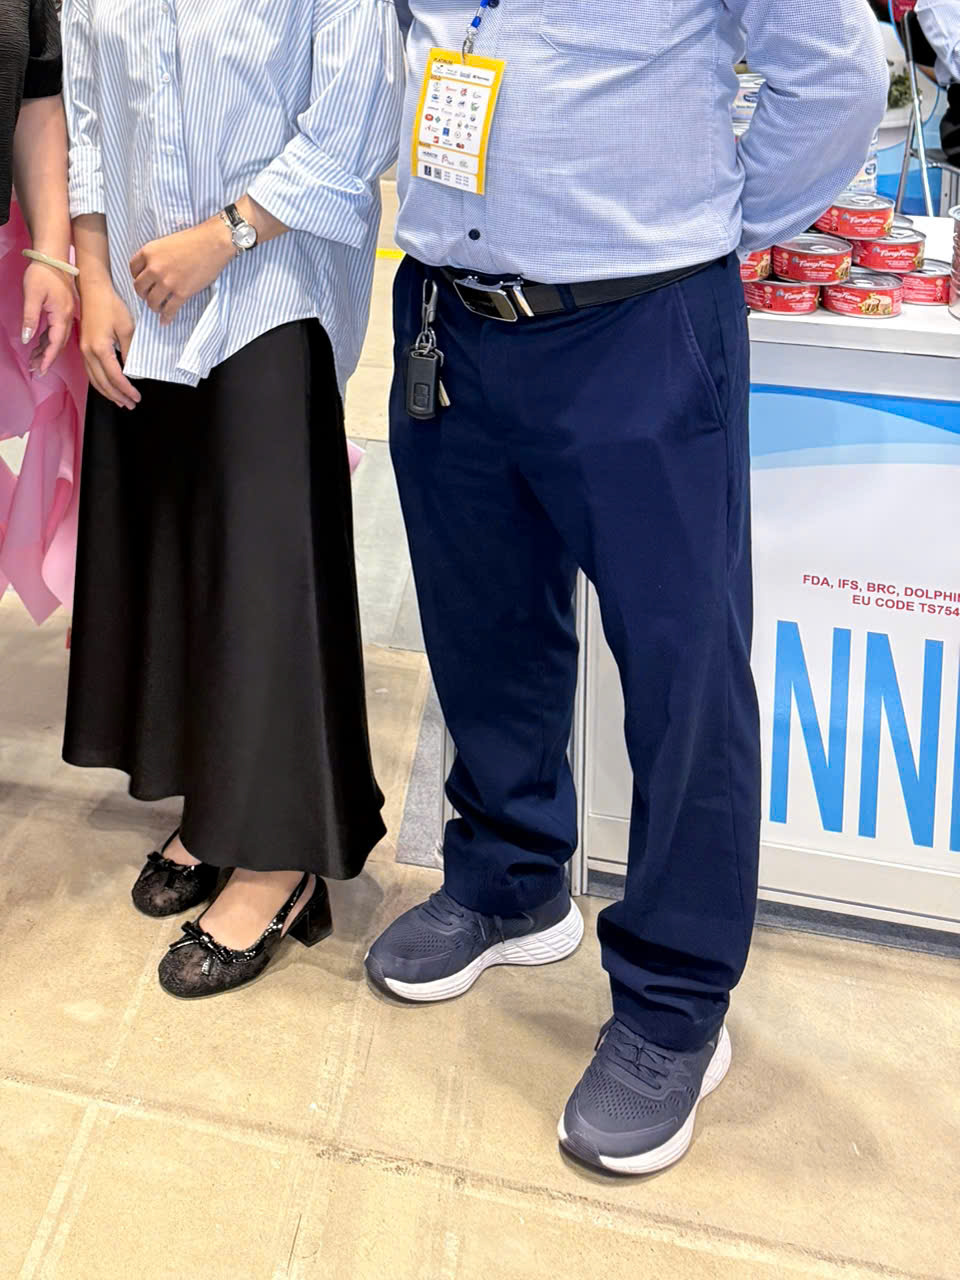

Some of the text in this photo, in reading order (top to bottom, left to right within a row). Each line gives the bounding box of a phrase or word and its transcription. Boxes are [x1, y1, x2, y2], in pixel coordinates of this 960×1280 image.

[802, 574, 960, 604] FDA, IFS, BRC, DOLPHI
[852, 594, 871, 606] EU
[874, 597, 915, 612] CODE
[768, 619, 960, 853] NN
